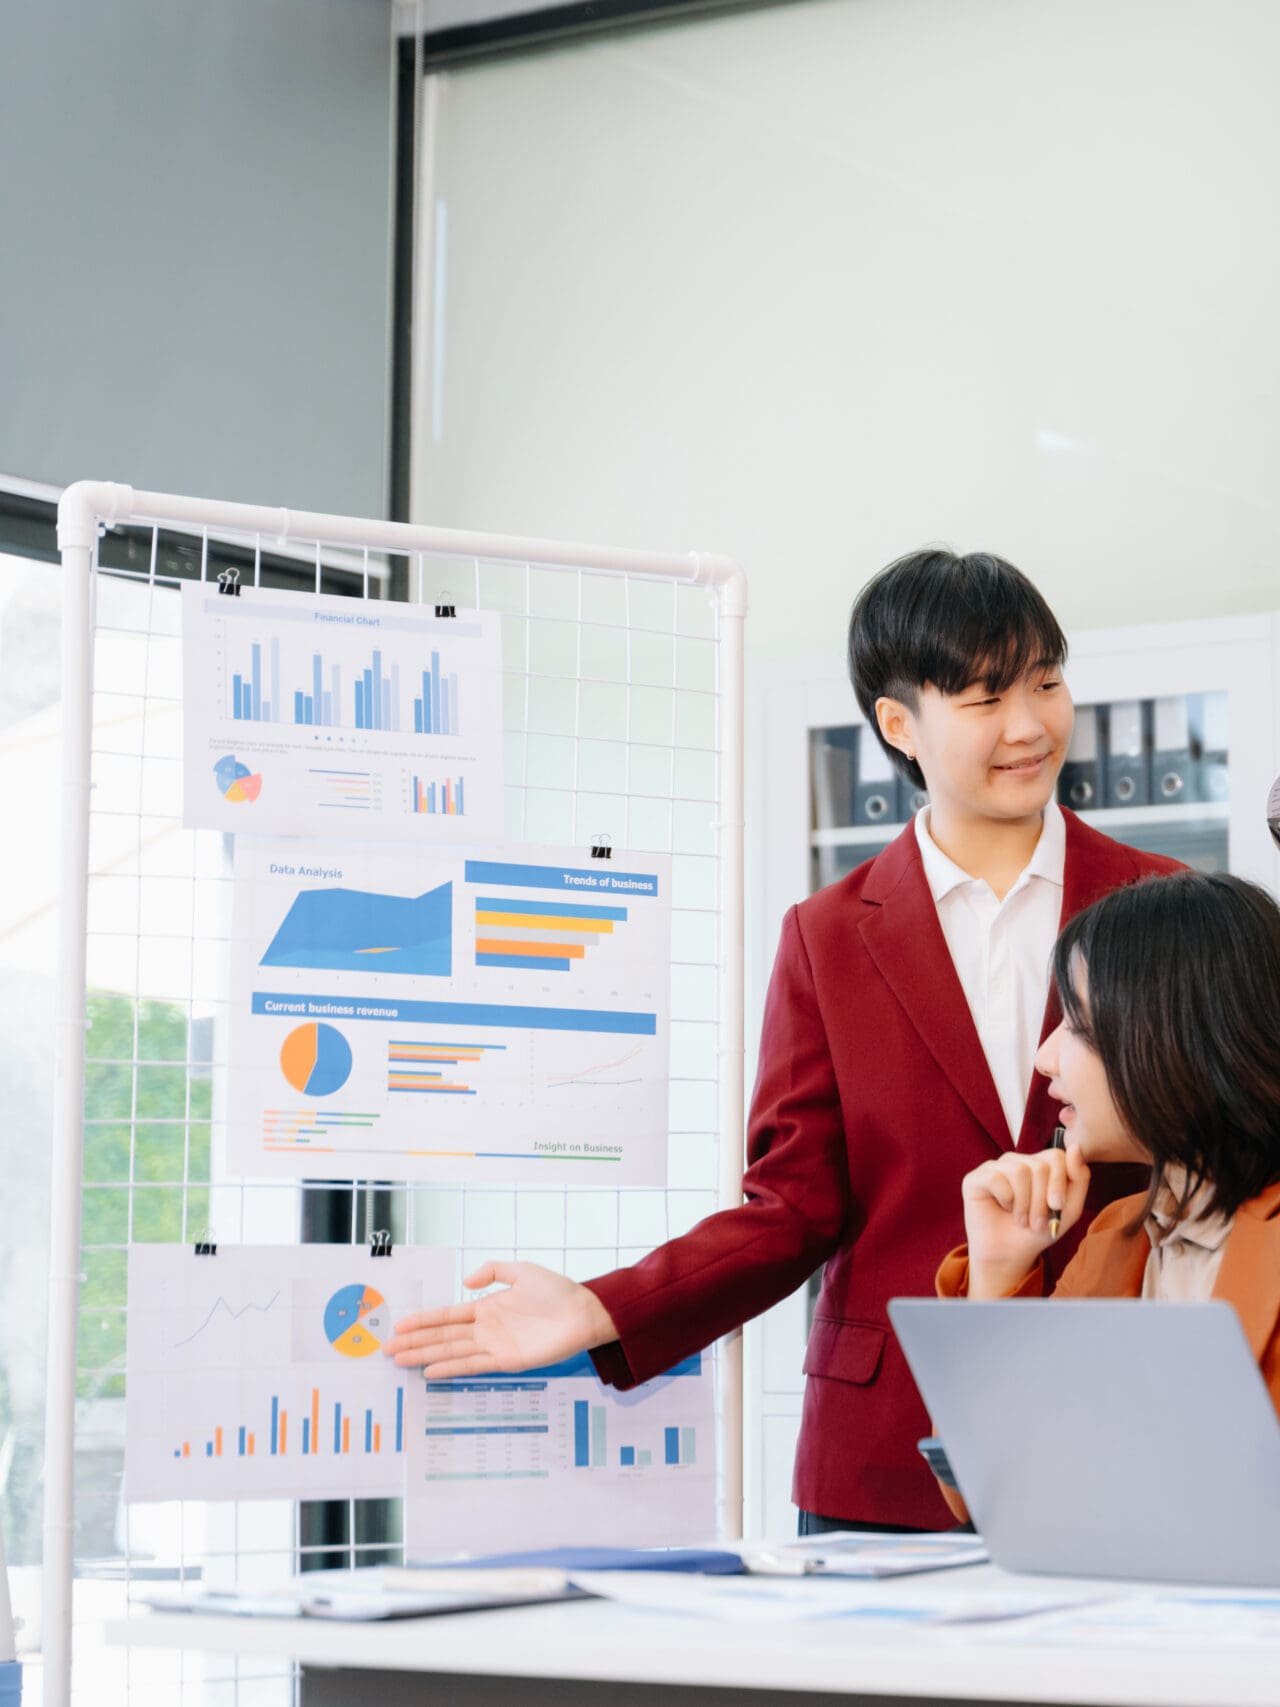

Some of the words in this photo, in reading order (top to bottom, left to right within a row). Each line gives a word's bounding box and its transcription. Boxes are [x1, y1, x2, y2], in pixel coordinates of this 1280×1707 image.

[314, 612, 354, 624] Financial
[356, 616, 380, 626] Chart
[270, 864, 295, 874] Data
[298, 866, 343, 878] Analysis
[563, 874, 597, 886] Trends
[599, 877, 610, 887] of
[611, 878, 653, 890] business
[265, 1000, 306, 1013] Current
[308, 1002, 354, 1015] business
[356, 1006, 398, 1017] revenue
[534, 1142, 567, 1152] Insight
[569, 1144, 581, 1152] on
[583, 1143, 623, 1153] Business
